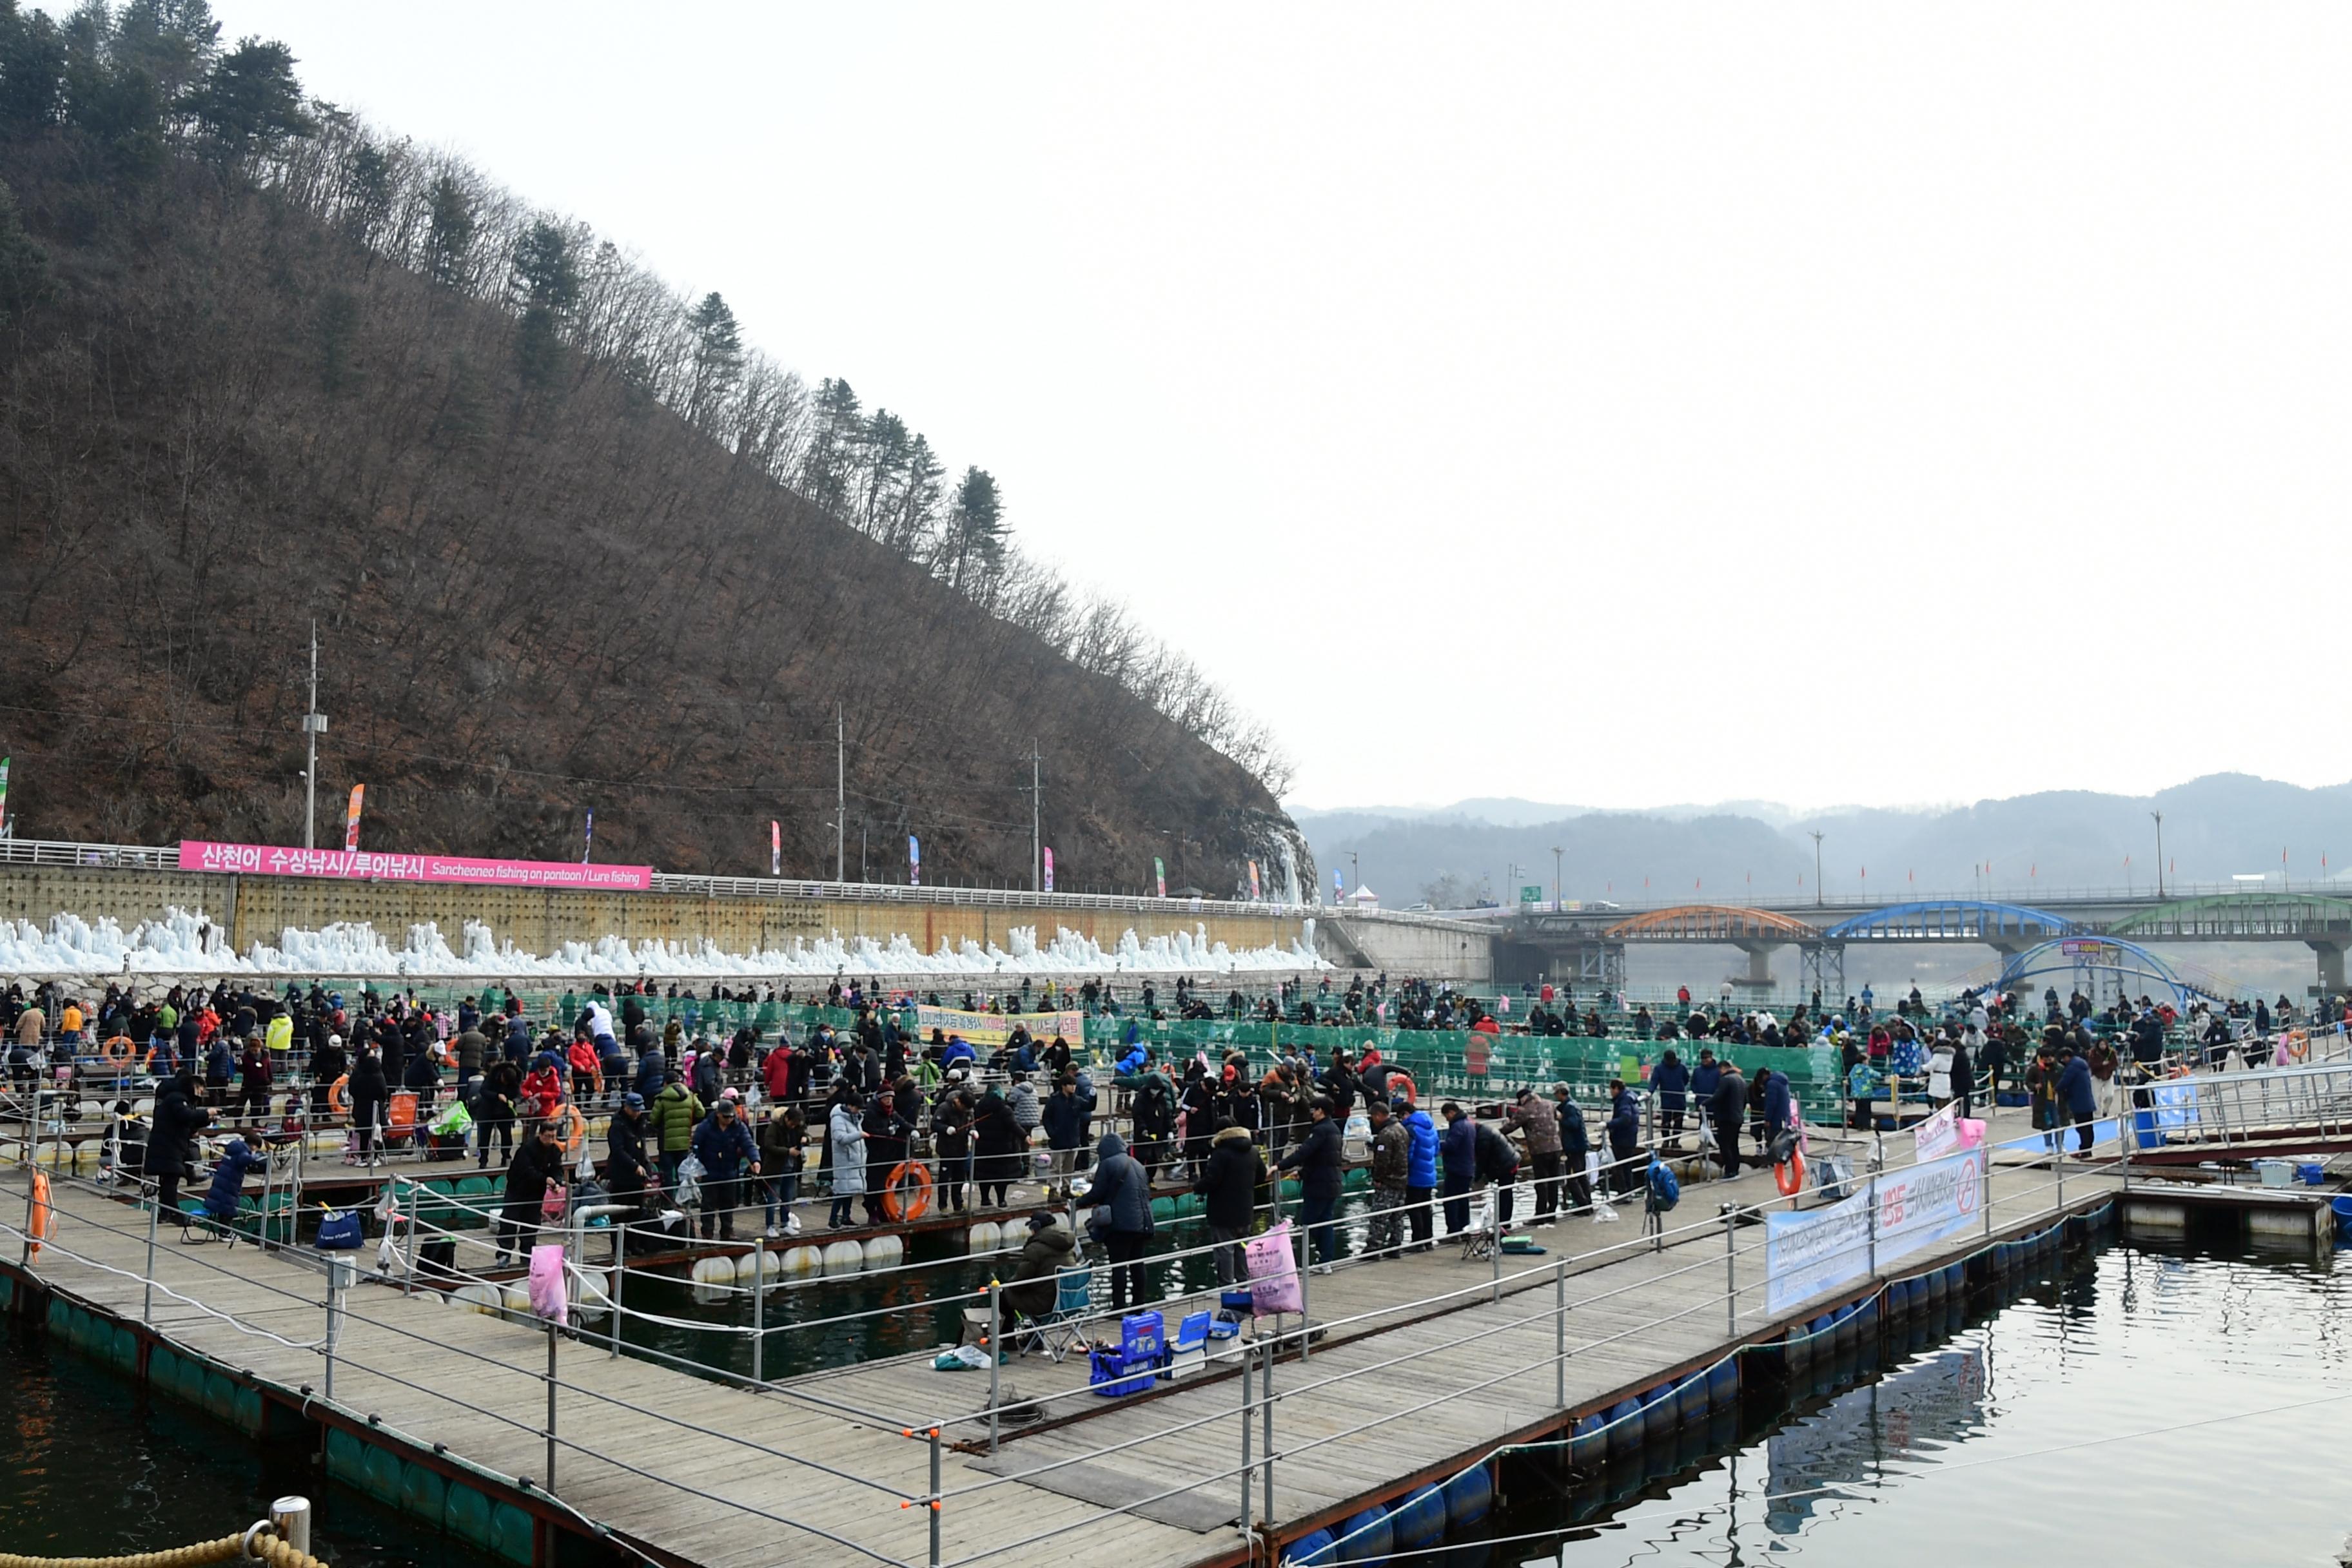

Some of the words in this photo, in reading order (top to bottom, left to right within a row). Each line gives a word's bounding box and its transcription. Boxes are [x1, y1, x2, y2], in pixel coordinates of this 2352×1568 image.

[202, 844, 261, 871] 산천어
[269, 848, 425, 878] 수상낚시/루어낚시
[432, 861, 495, 877] Sancheoneo
[496, 865, 528, 881] fishing
[530, 870, 542, 880] on
[611, 871, 640, 886] fishing
